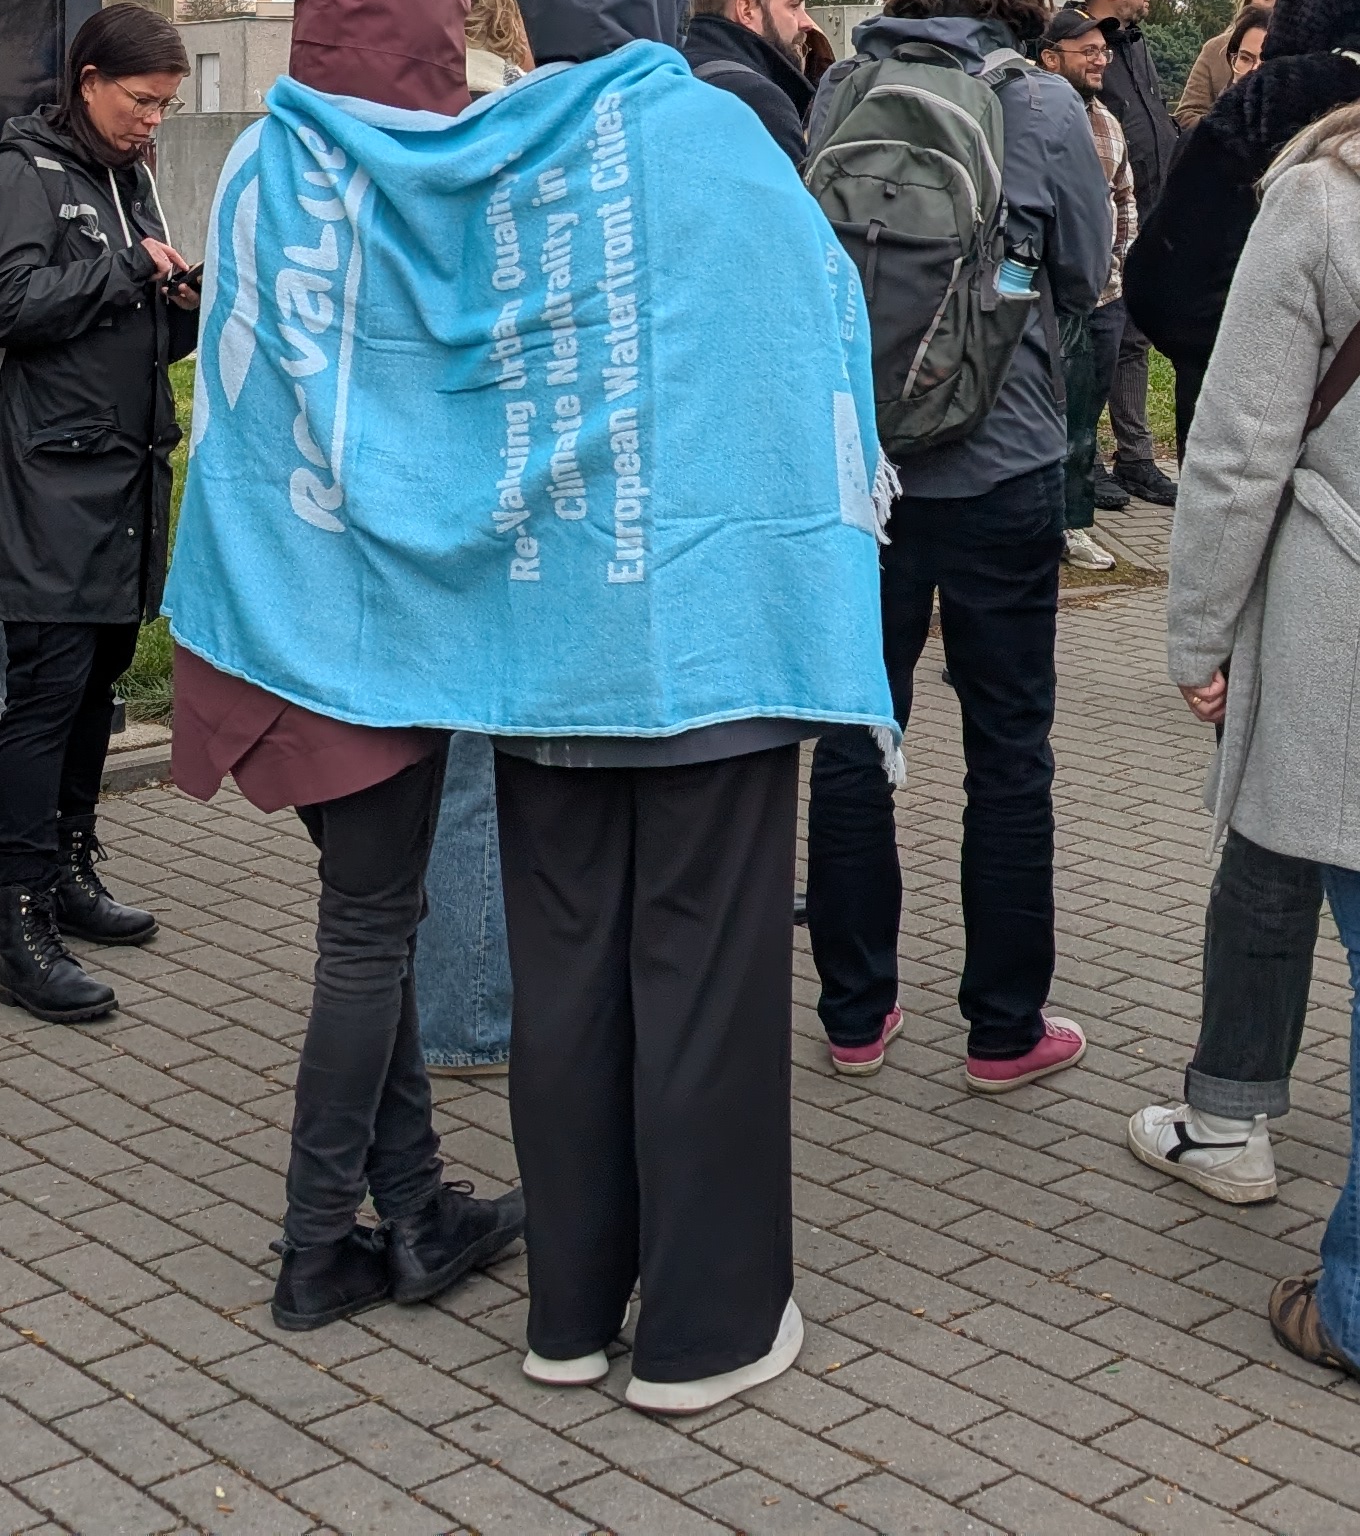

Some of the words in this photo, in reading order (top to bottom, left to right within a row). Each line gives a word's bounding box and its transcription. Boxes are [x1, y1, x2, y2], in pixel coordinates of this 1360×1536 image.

[532, 166, 568, 207] in
[586, 92, 630, 192] Cities
[490, 298, 527, 390] Urban
[539, 212, 580, 386] Neutrality
[596, 195, 639, 403] Waterfront
[492, 400, 541, 582] Re-Valuing
[546, 394, 587, 521] Climate
[607, 407, 651, 584] European
